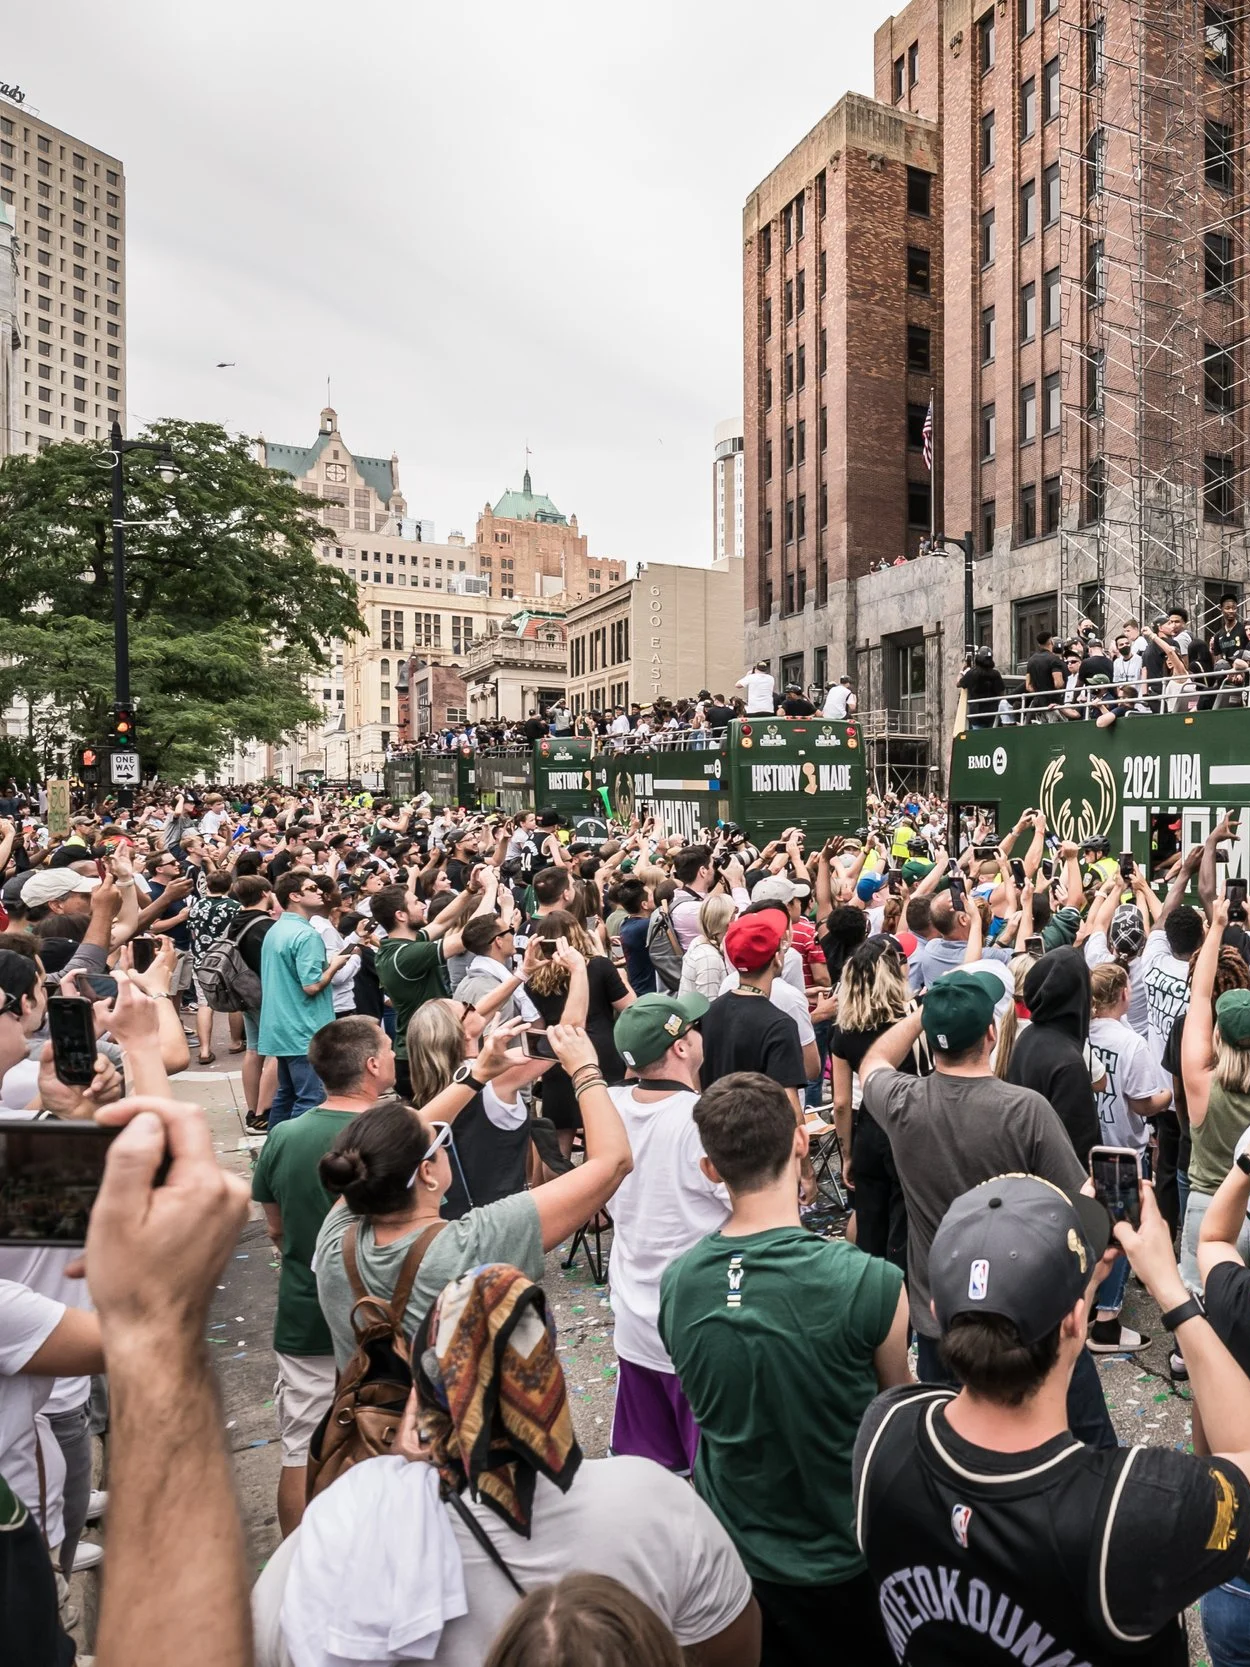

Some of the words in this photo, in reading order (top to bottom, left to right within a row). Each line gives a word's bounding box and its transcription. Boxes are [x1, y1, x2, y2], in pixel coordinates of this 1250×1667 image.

[0, 81, 26, 104] ady
[650, 584, 663, 628] 600
[651, 637, 663, 695] EAST
[115, 756, 135, 764] ONE
[115, 764, 135, 772] WAY
[968, 754, 991, 769] BMO
[548, 771, 583, 790] HISTORY
[751, 764, 801, 792] HISTORY
[819, 765, 852, 791] MADE
[1123, 755, 1161, 800] 2021
[1168, 753, 1202, 800] NBA
